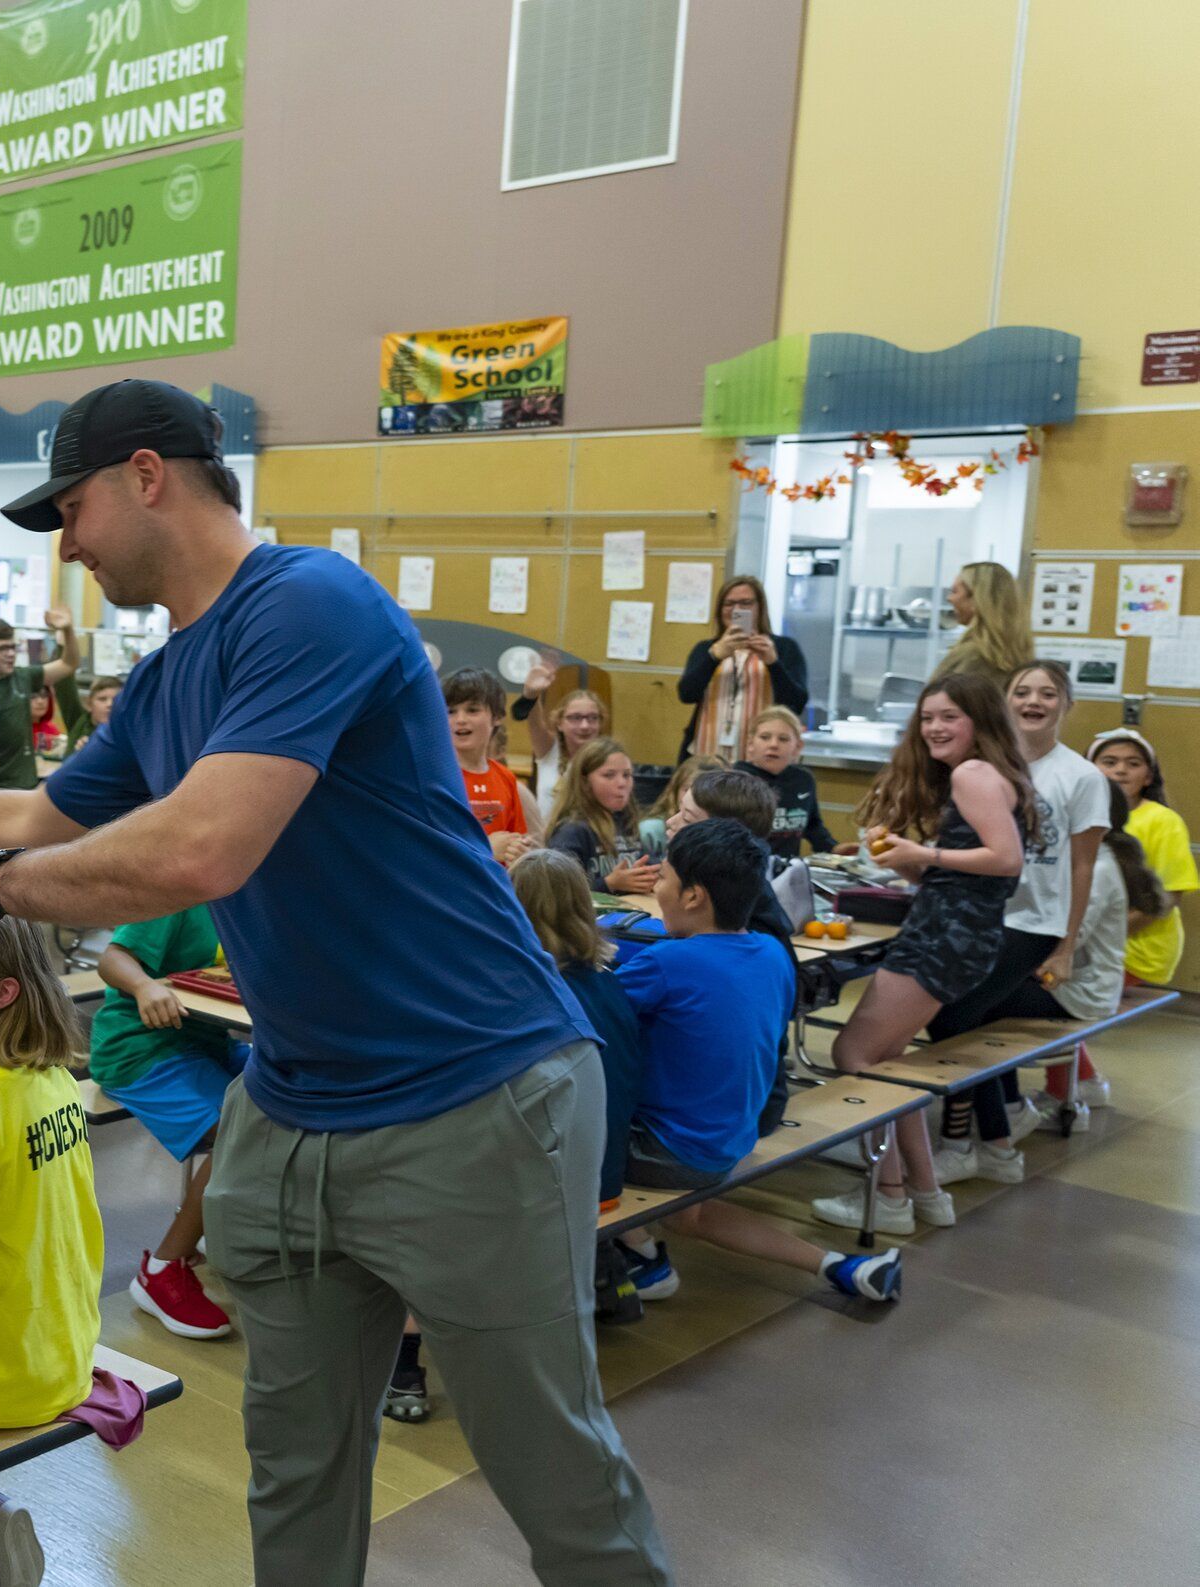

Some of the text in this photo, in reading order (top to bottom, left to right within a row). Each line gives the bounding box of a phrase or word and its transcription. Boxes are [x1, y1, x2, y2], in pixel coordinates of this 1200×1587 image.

[105, 35, 229, 98] ACHIEVEMENT
[101, 86, 227, 150] WINNER
[79, 204, 134, 253] 2009
[99, 250, 225, 301] ACHIEVEMENT
[92, 300, 225, 355] WINNER
[450, 341, 536, 365] Green
[453, 358, 554, 389] School
